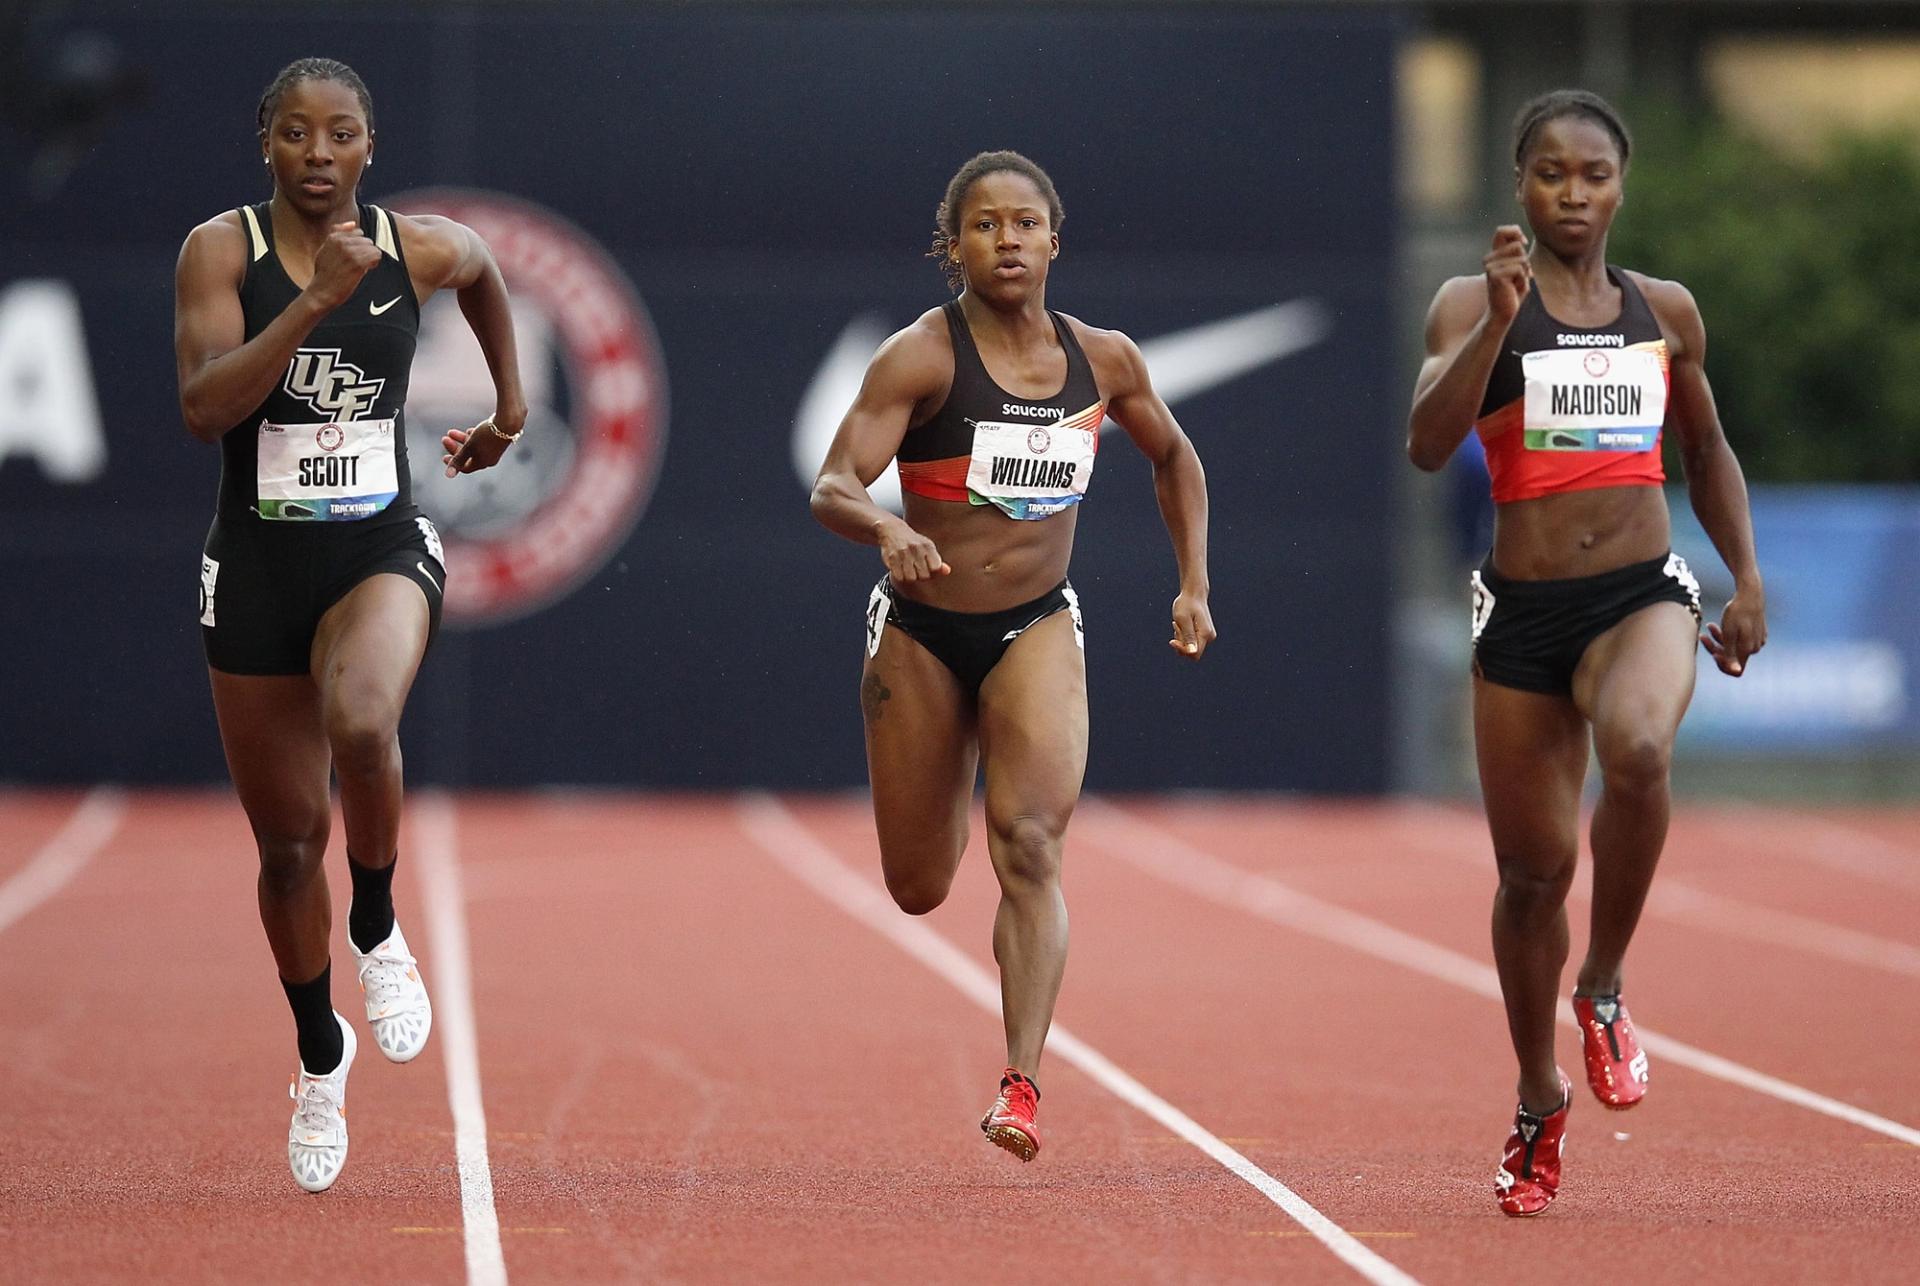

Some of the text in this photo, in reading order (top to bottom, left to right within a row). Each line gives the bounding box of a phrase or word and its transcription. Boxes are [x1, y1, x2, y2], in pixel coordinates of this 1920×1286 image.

[1556, 333, 1624, 347] saucony
[285, 348, 384, 421] UCF
[1552, 384, 1641, 416] MADISON
[1002, 403, 1065, 420] saucony
[298, 456, 360, 487] SCOTT
[990, 456, 1077, 488] WILLIAMS
